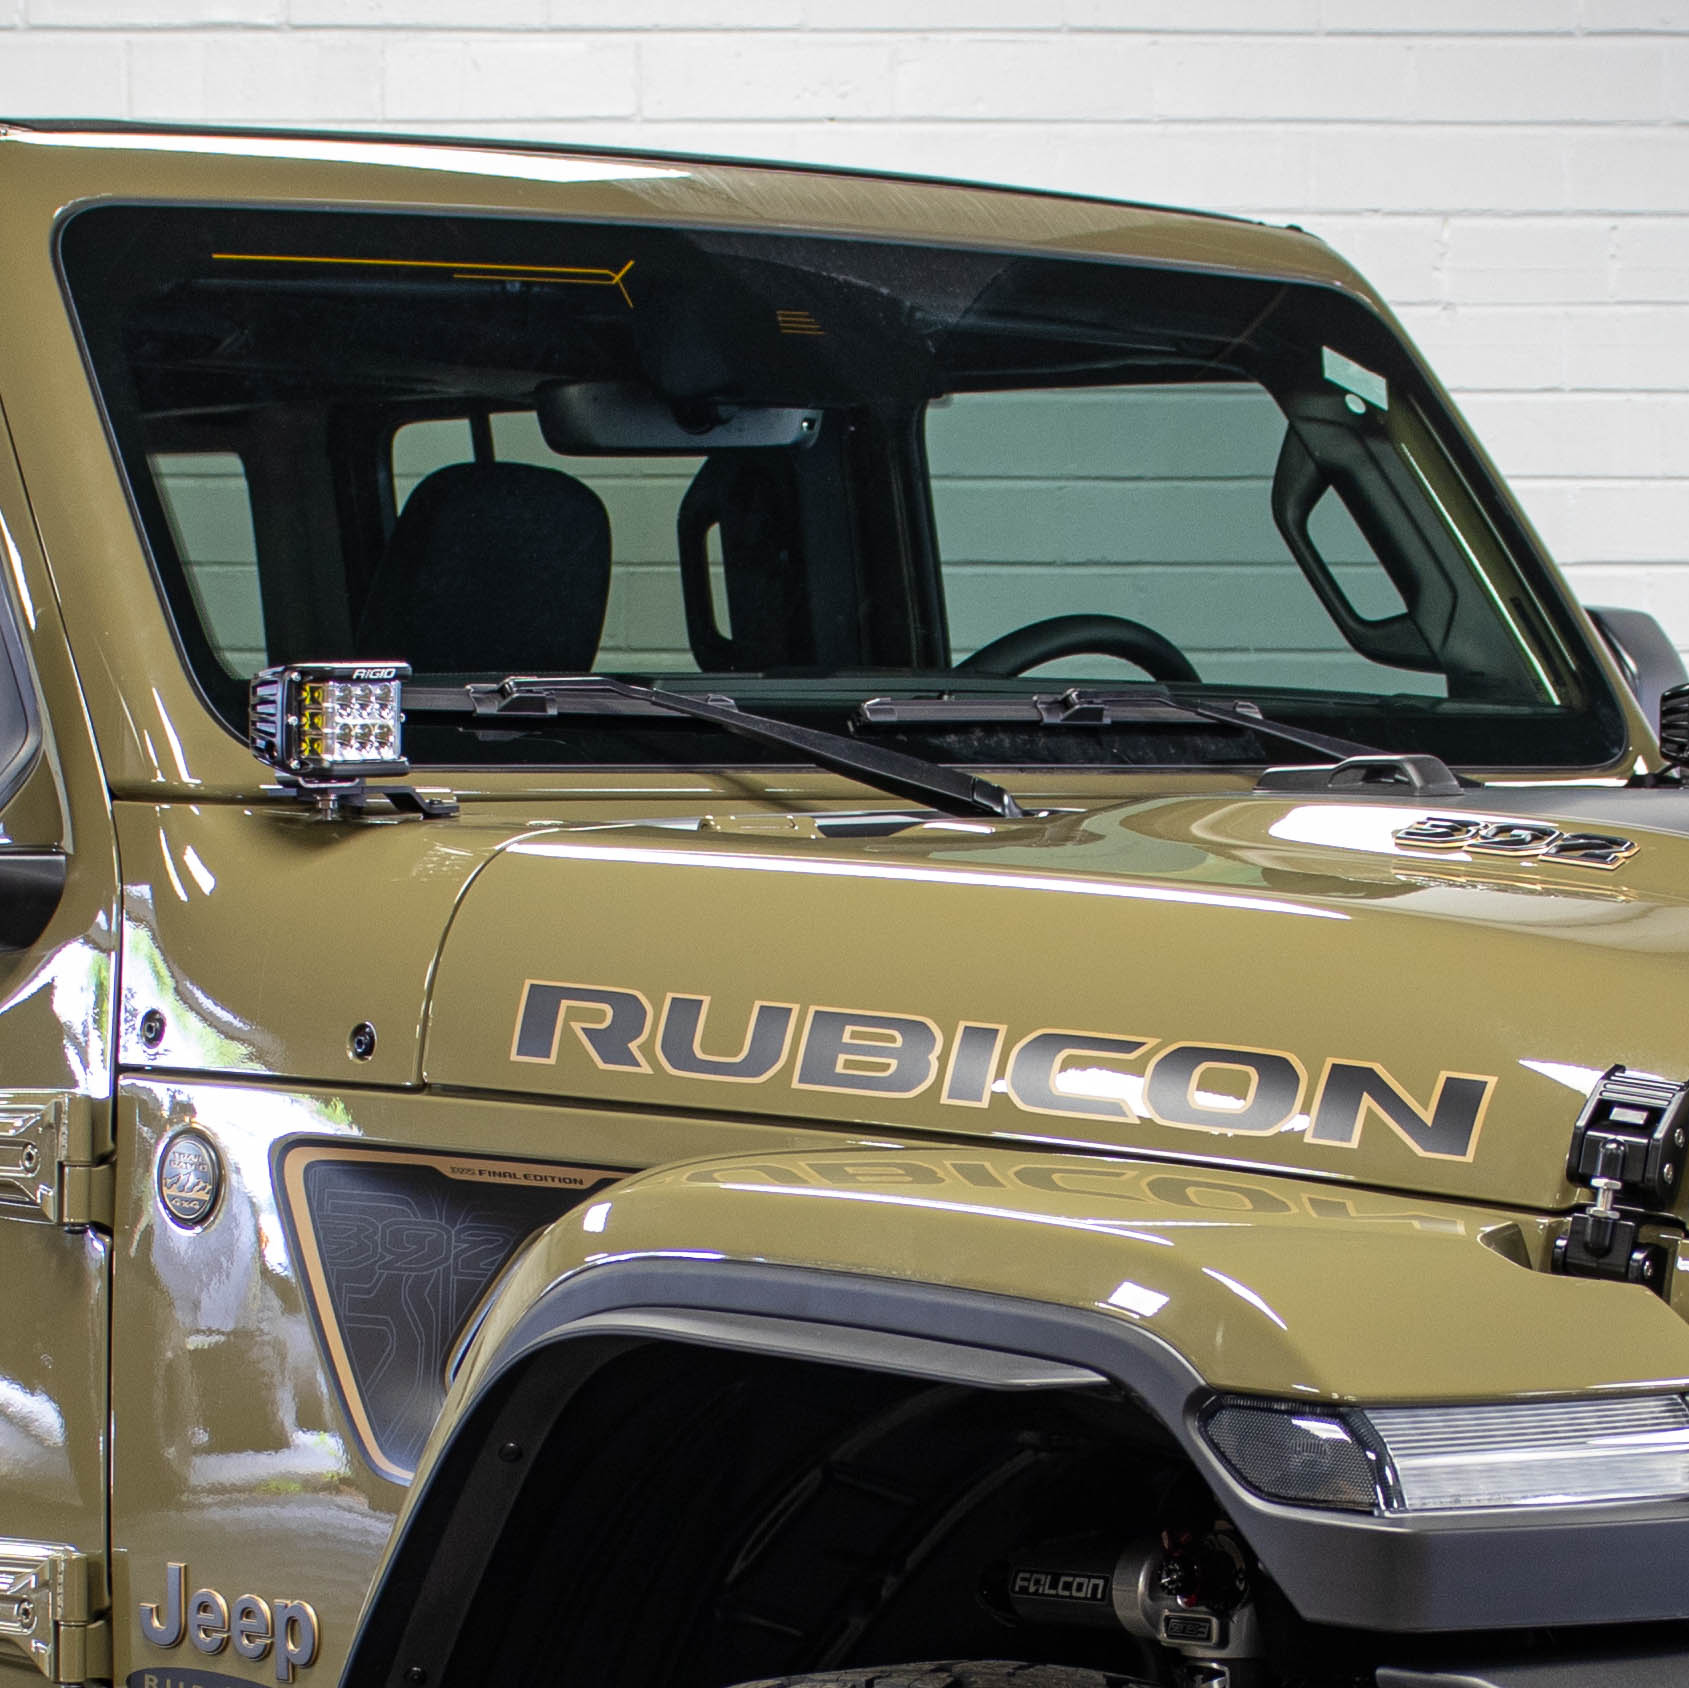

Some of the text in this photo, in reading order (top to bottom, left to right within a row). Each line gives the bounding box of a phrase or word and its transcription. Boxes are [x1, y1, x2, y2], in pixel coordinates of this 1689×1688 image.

[352, 667, 397, 680] RIGID
[1394, 816, 1641, 871] 392
[509, 978, 1497, 1164] RUBICON
[477, 1168, 522, 1180] FINAL
[523, 1173, 585, 1186] EDITION
[1013, 1571, 1106, 1600] FALCON
[139, 1561, 321, 1684] Jeep
